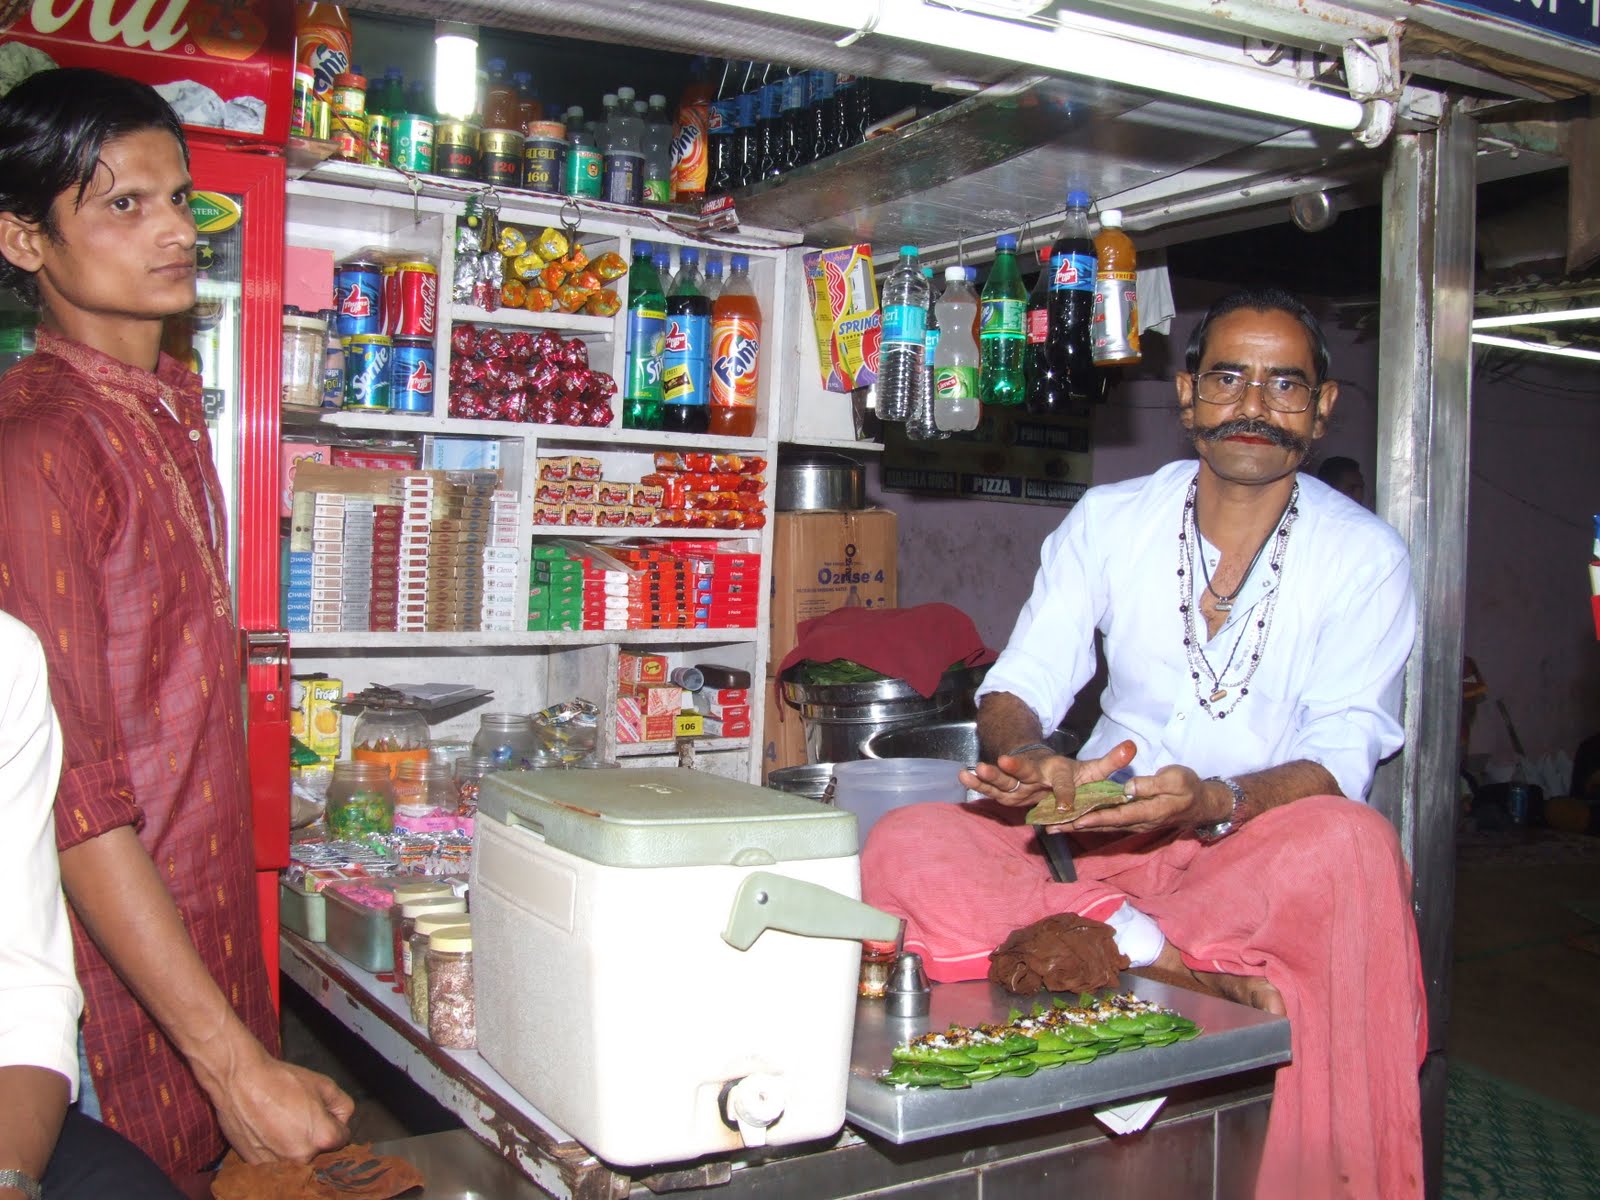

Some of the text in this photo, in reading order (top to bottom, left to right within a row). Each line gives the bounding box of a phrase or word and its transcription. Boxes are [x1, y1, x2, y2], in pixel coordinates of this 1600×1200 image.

[527, 171, 549, 183] 160
[839, 314, 880, 336] SPRING
[713, 339, 760, 390] Fanta
[352, 347, 389, 402] Sprite
[973, 477, 1011, 494] PIZZA
[874, 568, 885, 584] 4
[288, 615, 309, 623] CHARMS
[680, 723, 696, 731] 106
